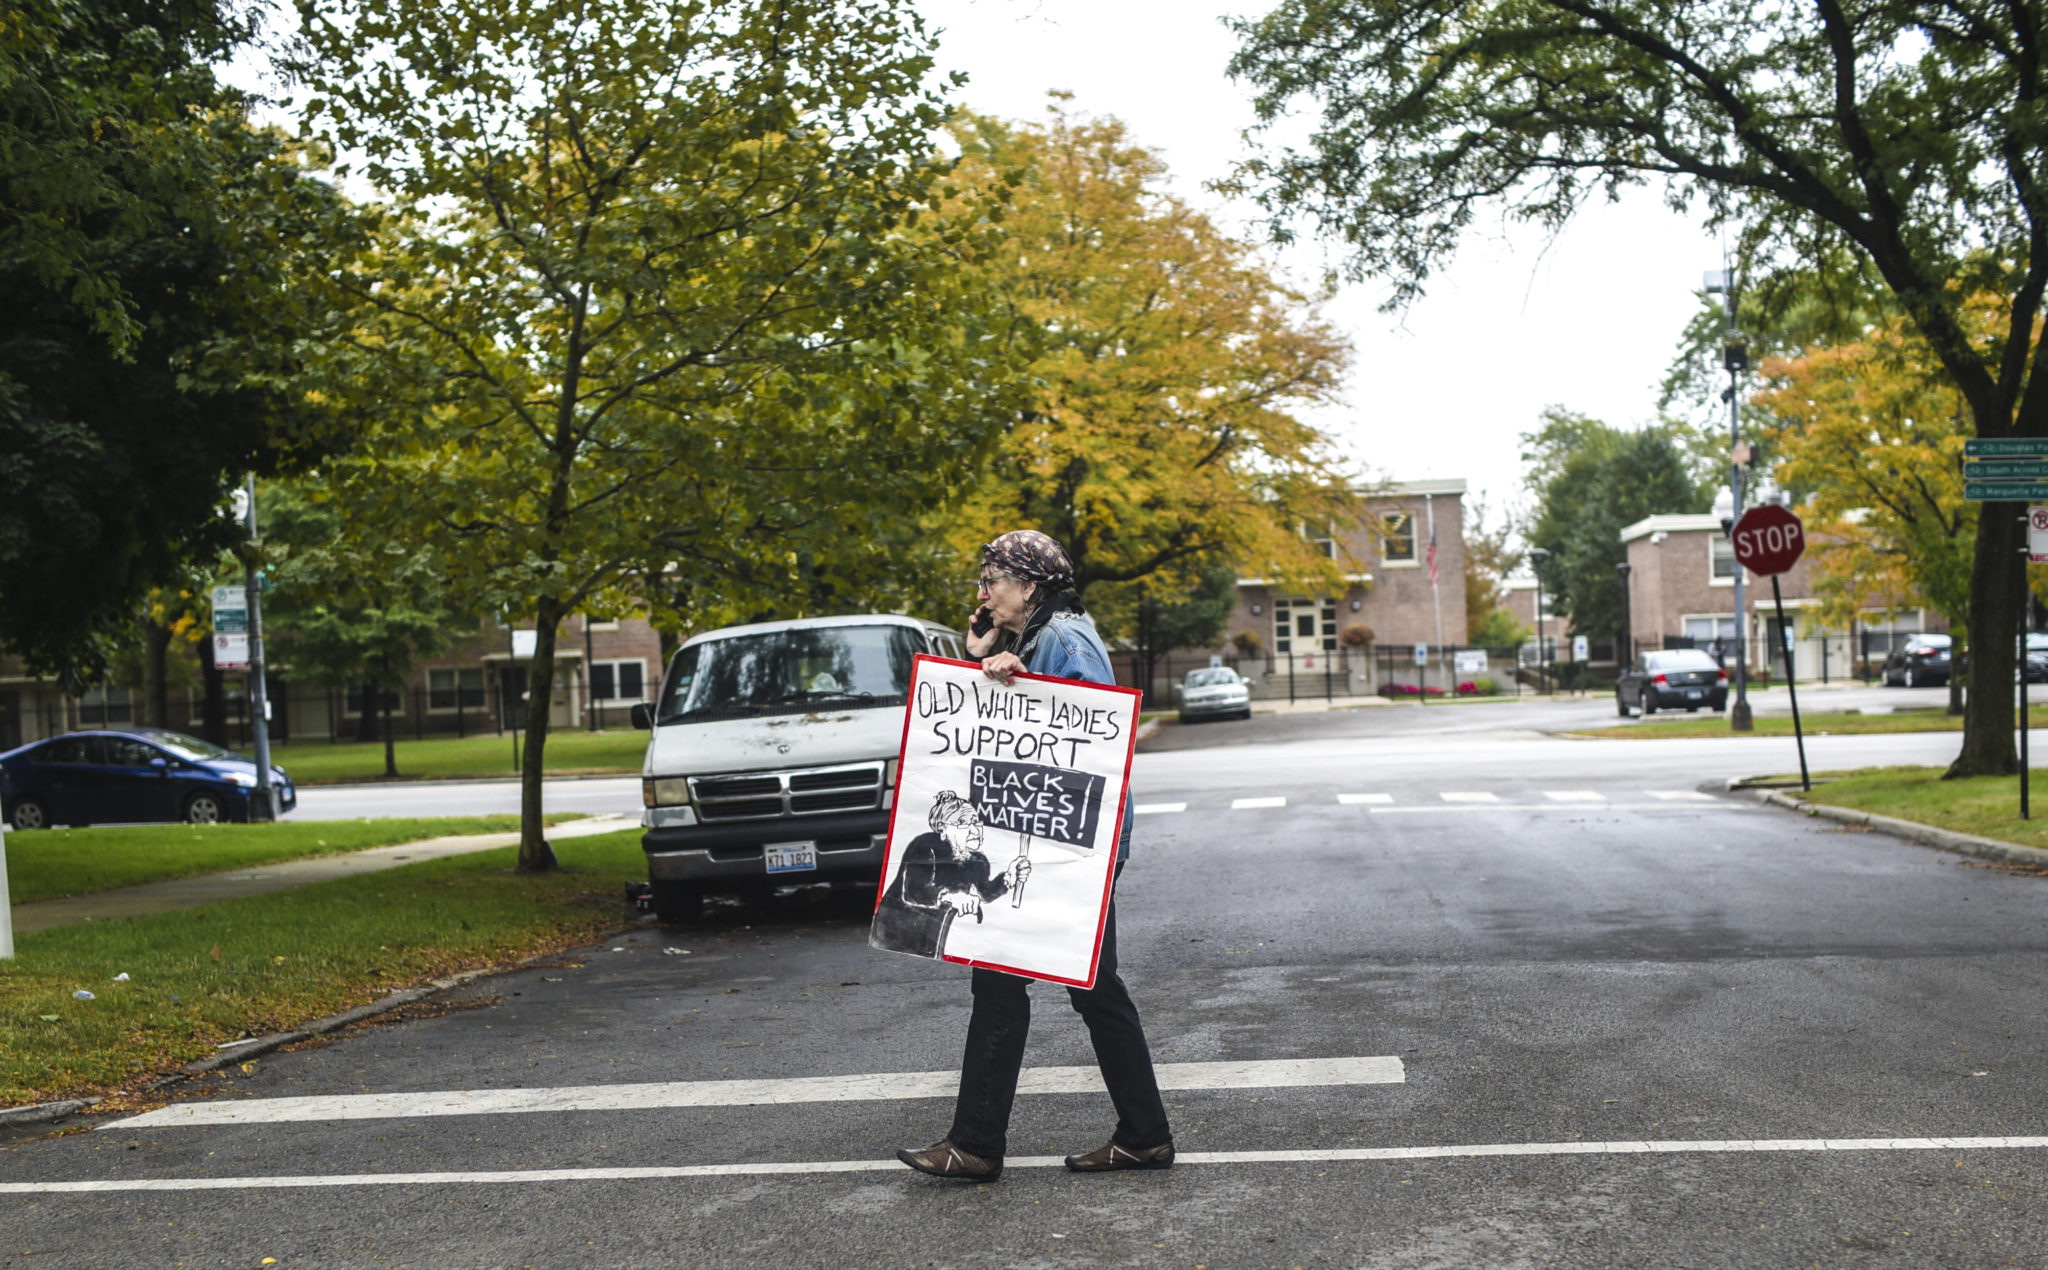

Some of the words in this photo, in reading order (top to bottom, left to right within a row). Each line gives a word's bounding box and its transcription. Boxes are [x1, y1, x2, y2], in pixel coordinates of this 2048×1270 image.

[1737, 523, 1799, 558] STOP
[918, 681, 965, 719] OLD
[972, 680, 1043, 723] WHITE
[1048, 694, 1120, 741] LADIES
[930, 720, 1092, 768] SUPPORT
[972, 765, 1065, 792] BLACK
[982, 785, 1075, 816] LIVES
